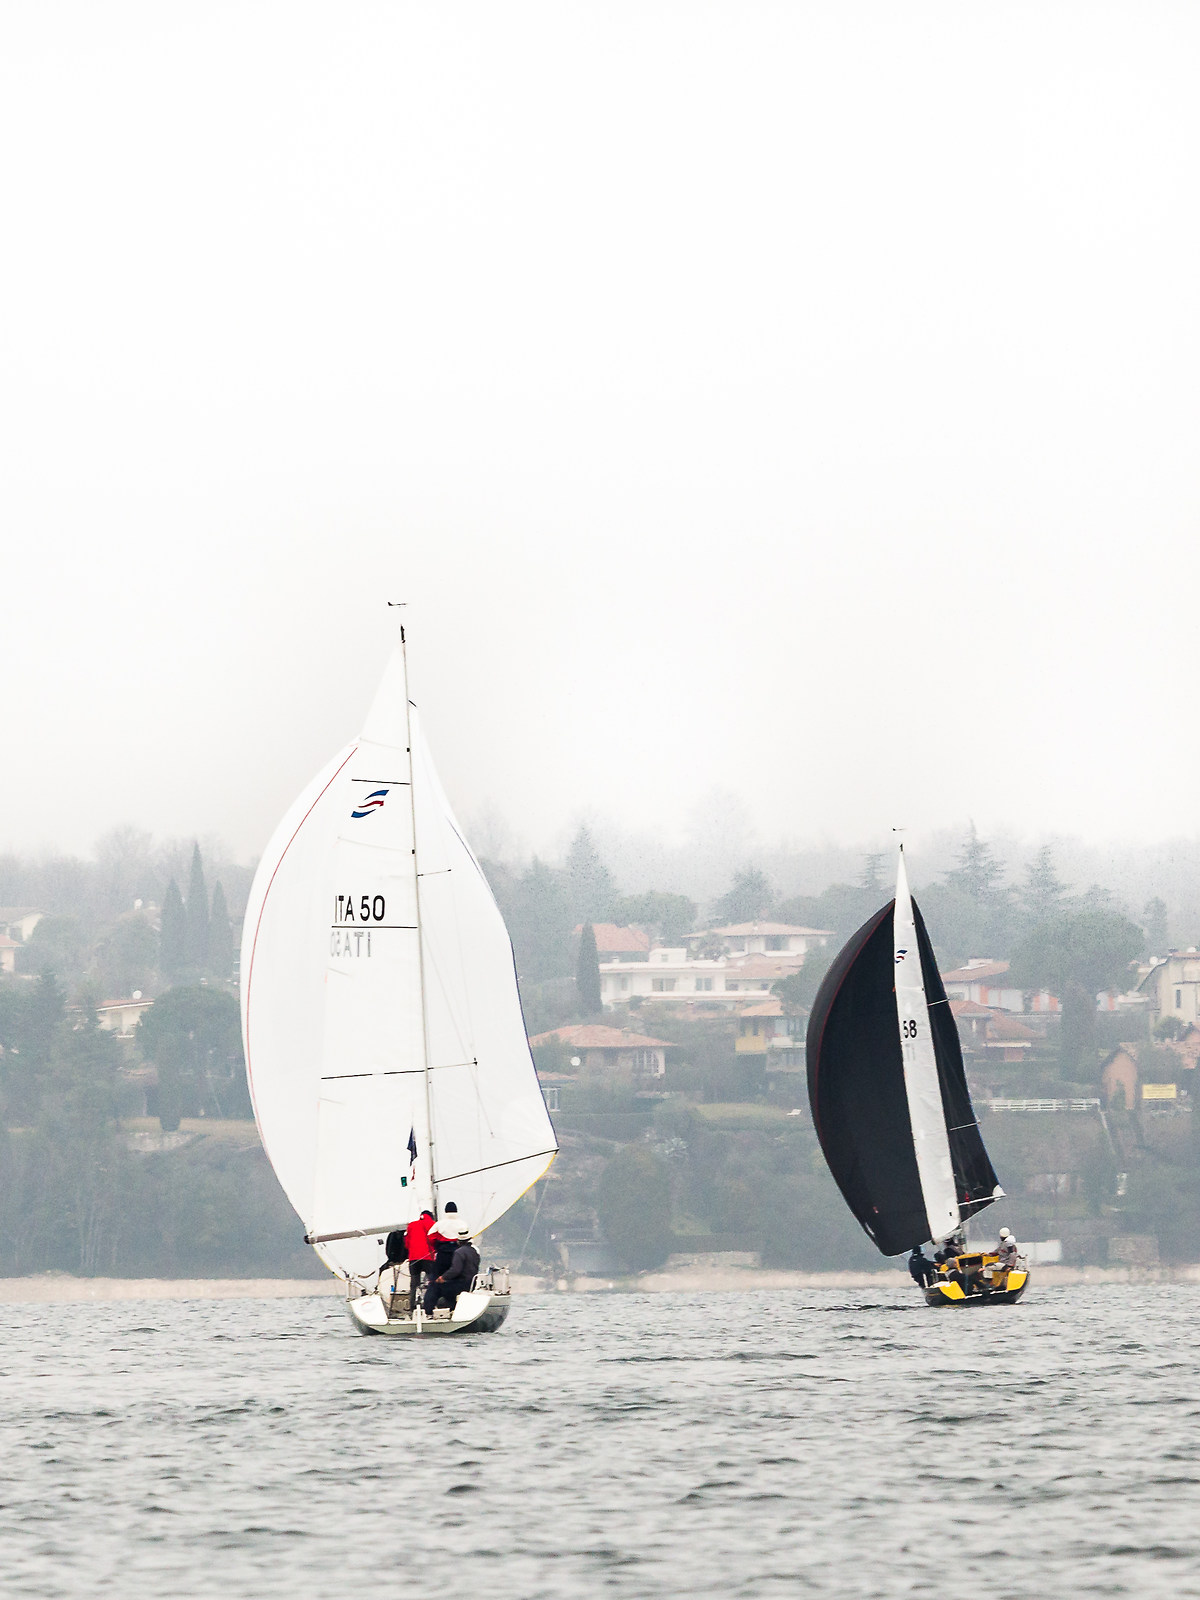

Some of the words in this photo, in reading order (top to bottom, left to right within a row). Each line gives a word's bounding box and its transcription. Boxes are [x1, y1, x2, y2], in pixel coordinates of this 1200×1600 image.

[335, 895, 355, 923] ITA
[360, 895, 385, 921] 50
[903, 1019, 917, 1039] 58
